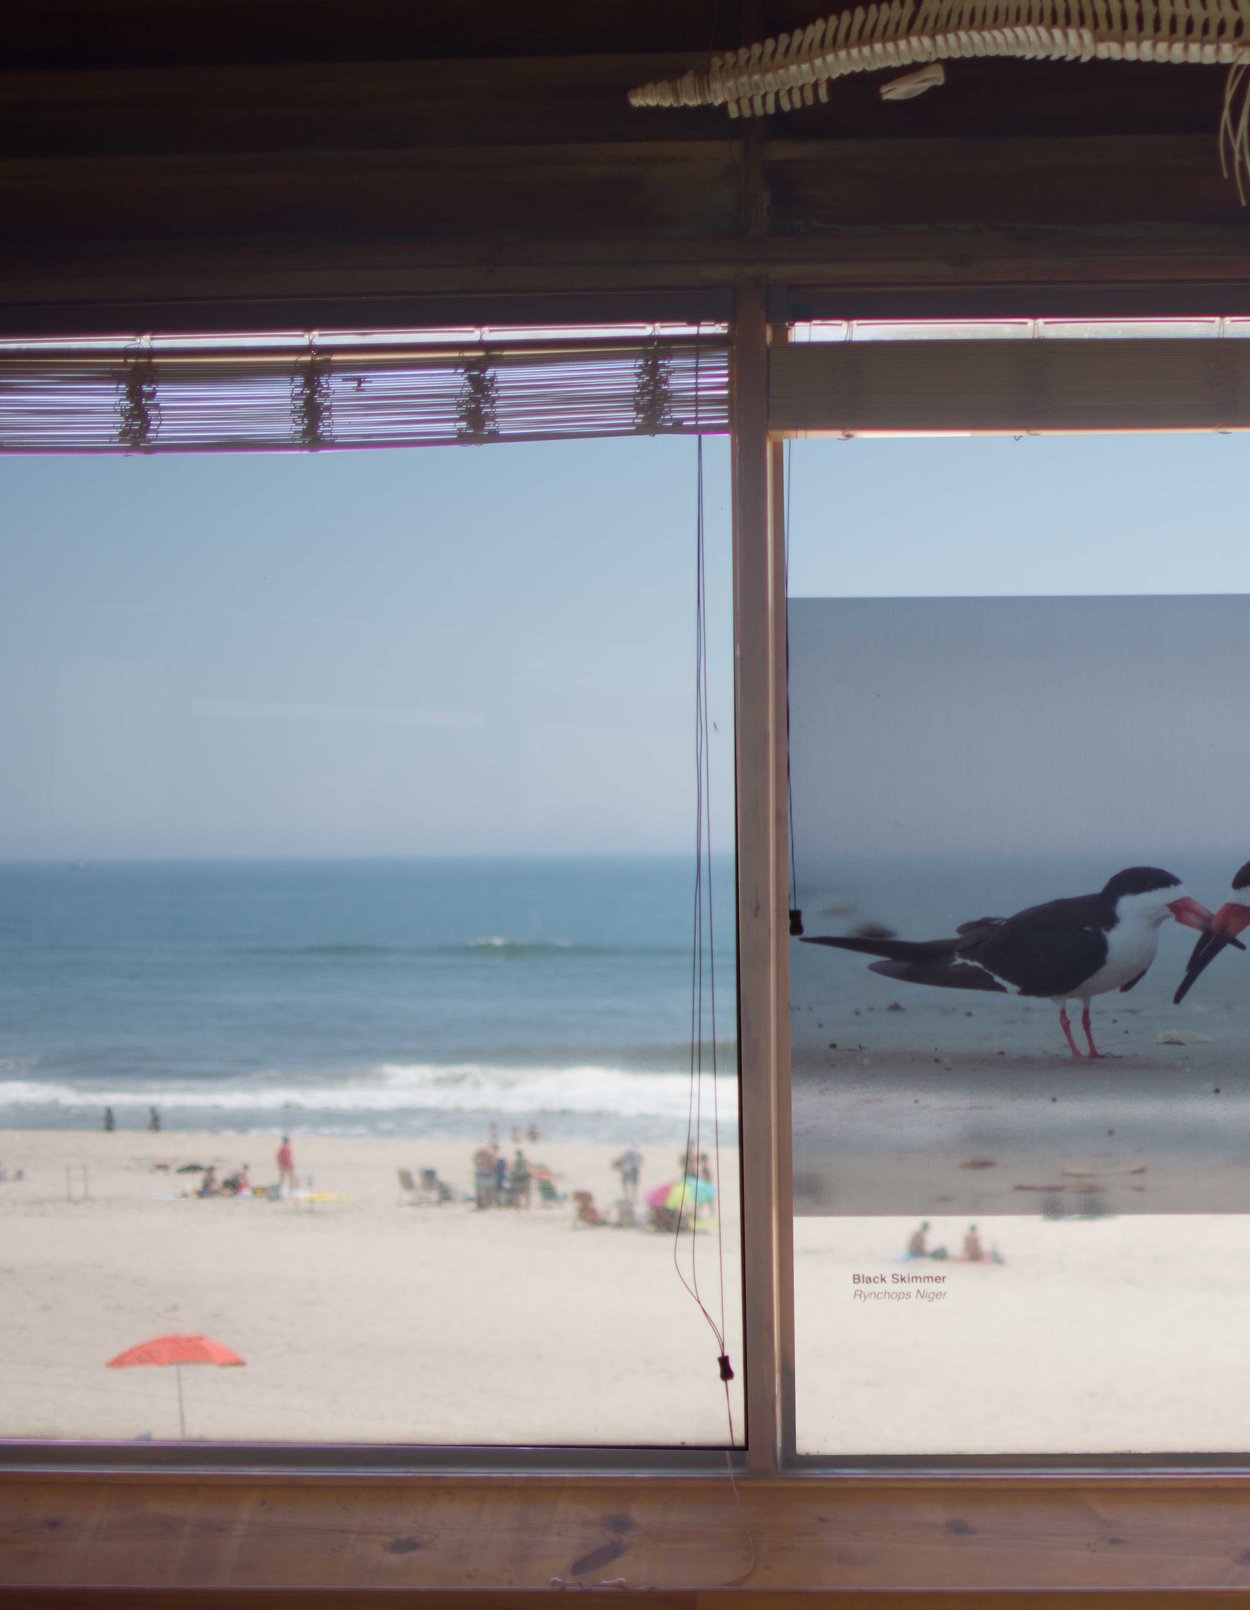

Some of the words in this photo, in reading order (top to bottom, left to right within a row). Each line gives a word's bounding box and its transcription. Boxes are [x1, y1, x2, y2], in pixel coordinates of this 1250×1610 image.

[852, 1274, 887, 1284] Black
[891, 1273, 947, 1284] Skimmer
[853, 1289, 912, 1302] Rynchops
[915, 1289, 948, 1302] Niger
